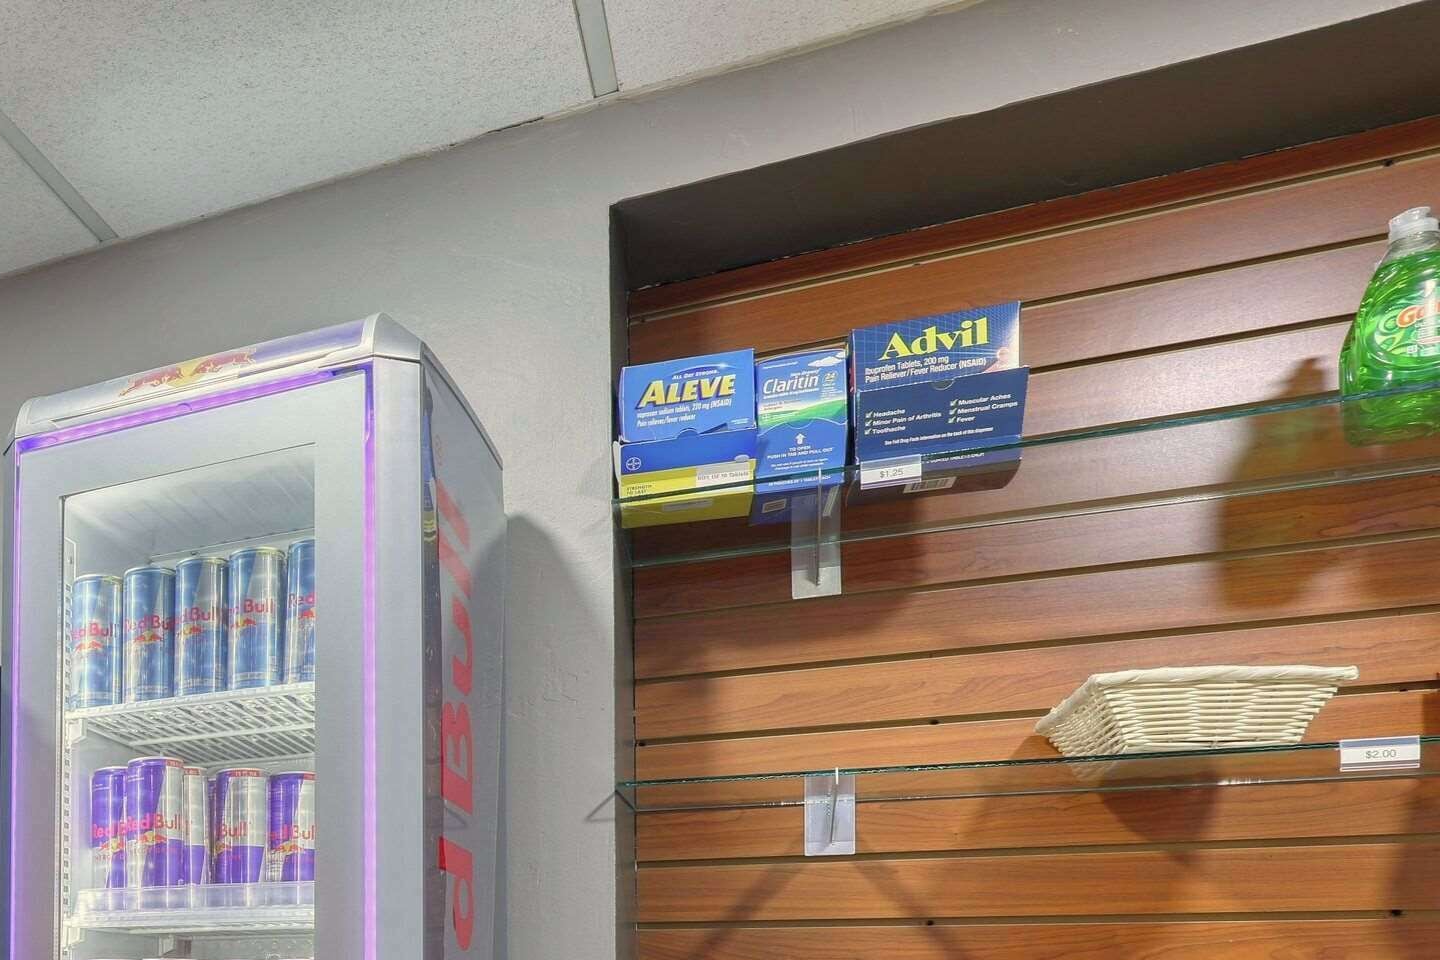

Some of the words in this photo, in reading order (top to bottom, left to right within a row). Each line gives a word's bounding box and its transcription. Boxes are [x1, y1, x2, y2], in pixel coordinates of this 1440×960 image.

[879, 317, 989, 361] Advil
[637, 374, 736, 409] ALEVE
[763, 374, 819, 394] Claritin
[880, 467, 903, 478] $1.25
[437, 478, 474, 815] Bull
[1366, 749, 1396, 759] $2.00
